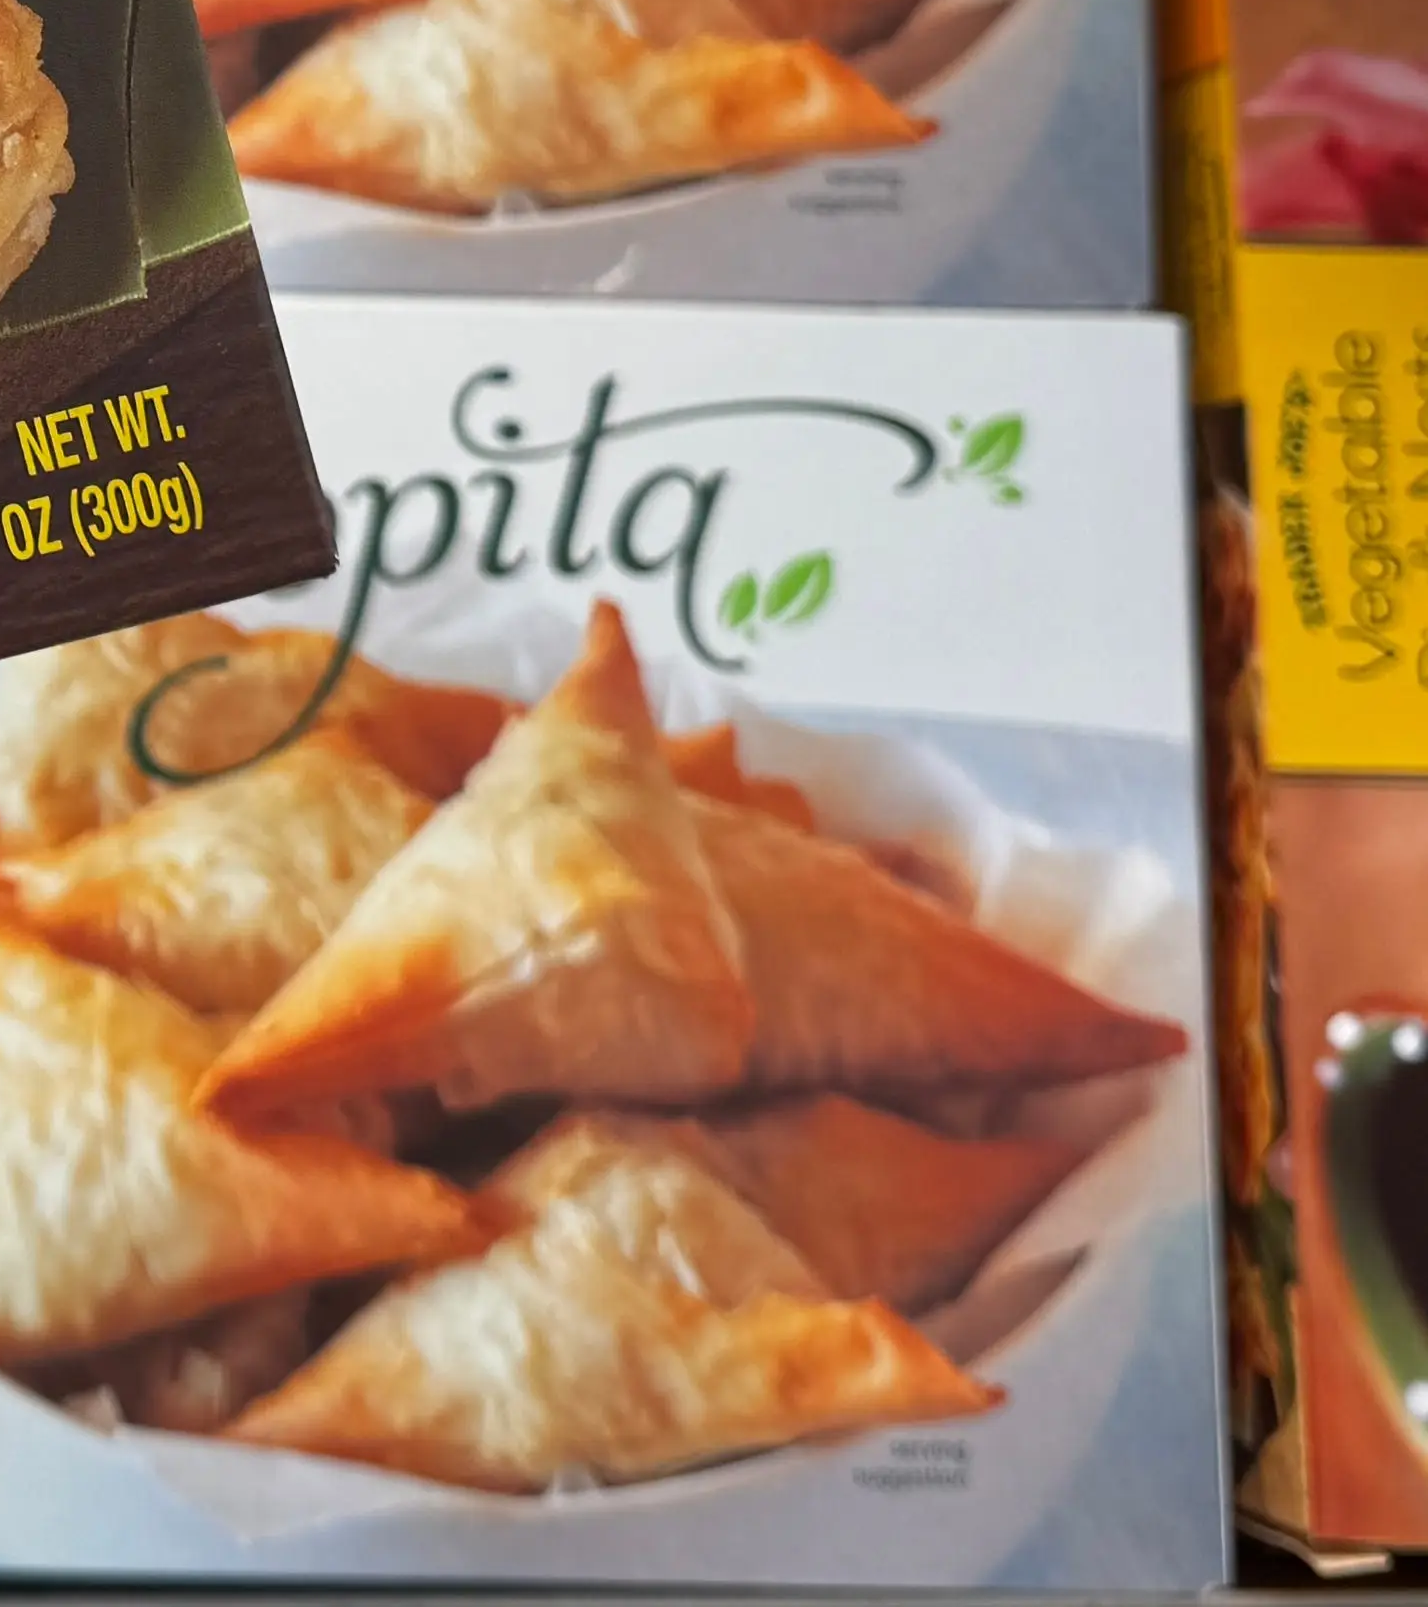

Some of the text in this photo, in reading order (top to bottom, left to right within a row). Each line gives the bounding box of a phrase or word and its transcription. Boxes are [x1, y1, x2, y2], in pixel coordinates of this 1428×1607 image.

[1, 496, 64, 561] OZ
[70, 461, 203, 557] (300g)
[15, 385, 186, 476] NET WT.
[1321, 330, 1401, 683] Vegetable
[127, 366, 939, 785] pita
